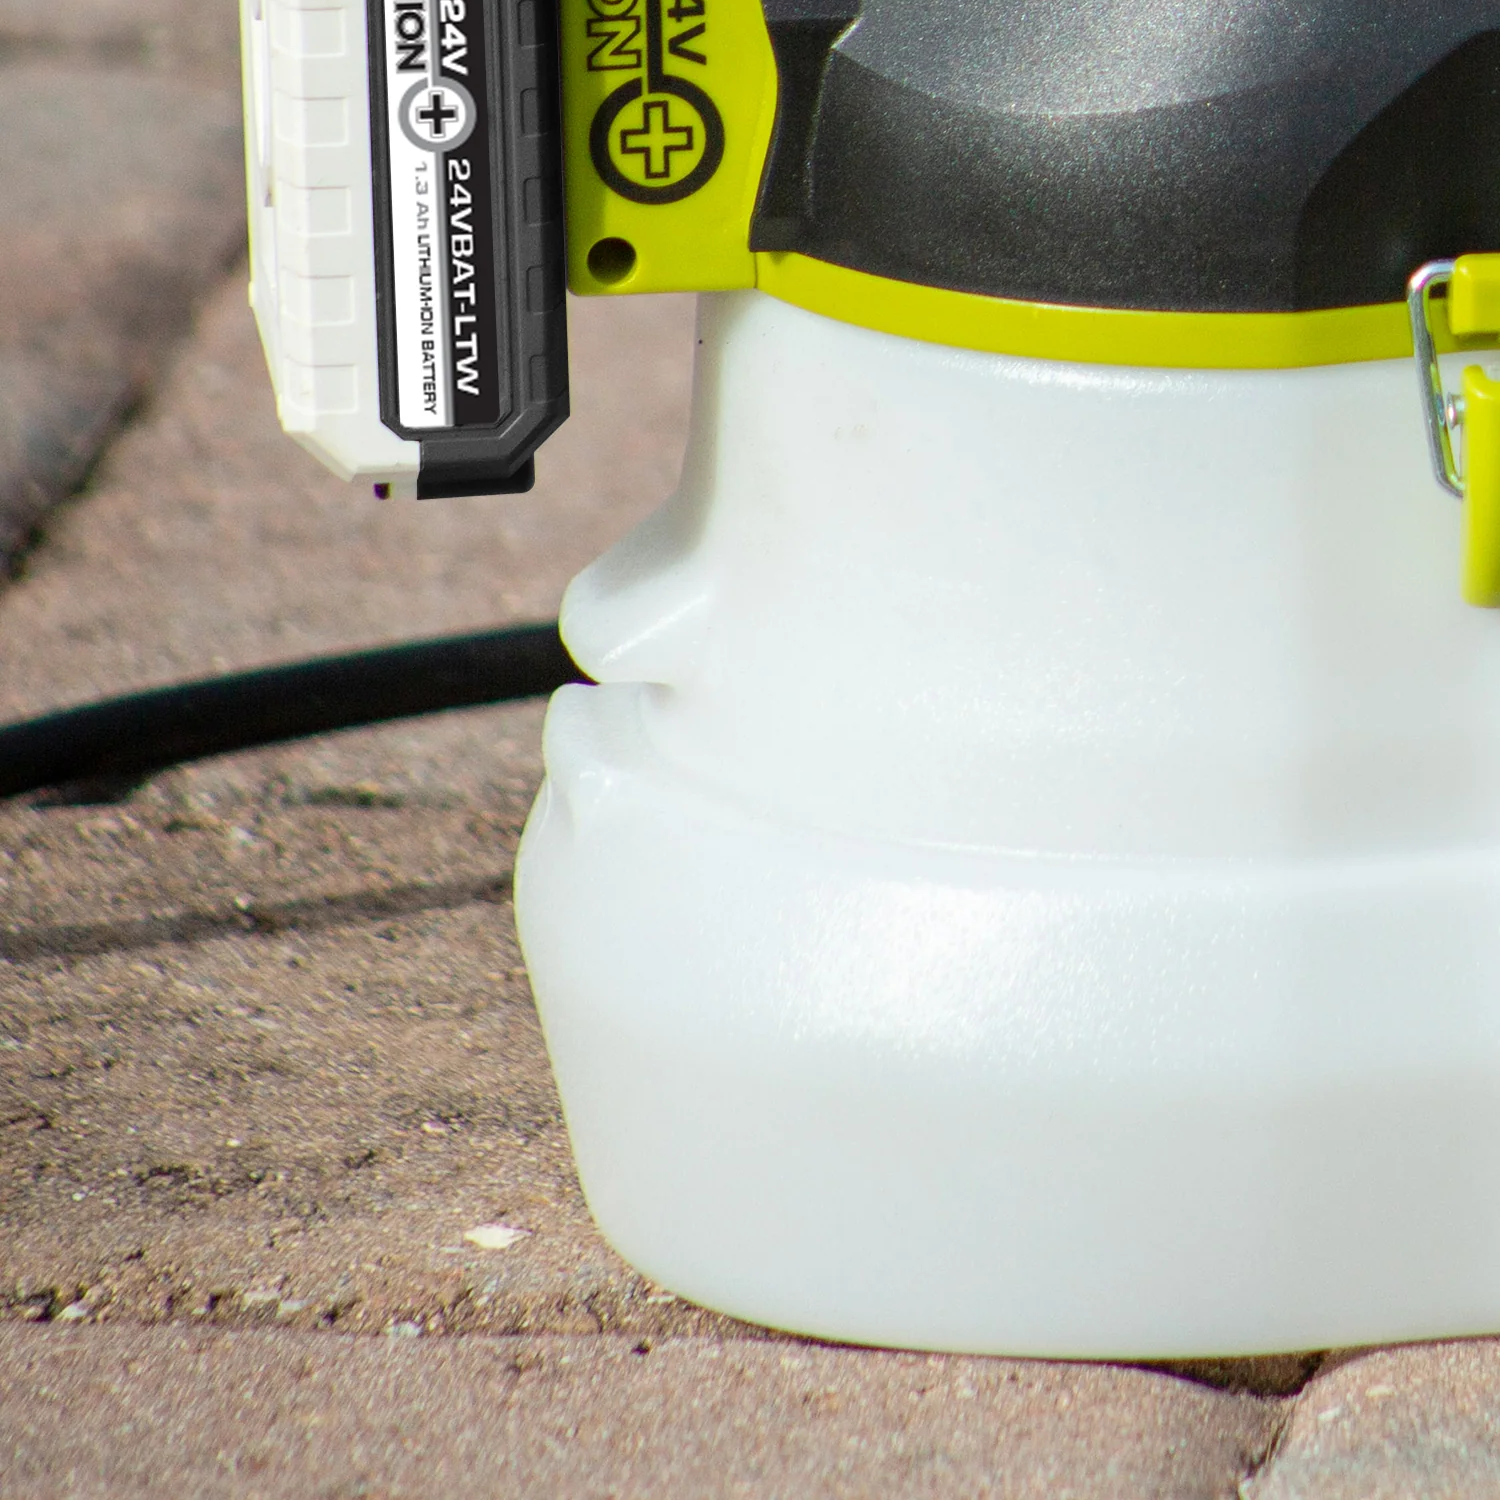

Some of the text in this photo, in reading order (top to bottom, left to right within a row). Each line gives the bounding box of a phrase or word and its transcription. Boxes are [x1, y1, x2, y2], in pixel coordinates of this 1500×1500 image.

[393, 0, 427, 74] ION
[414, 160, 437, 416] 1.3 Ah LITHIUM-ION BATTERY
[447, 158, 480, 396] 24VBAT-LTW
